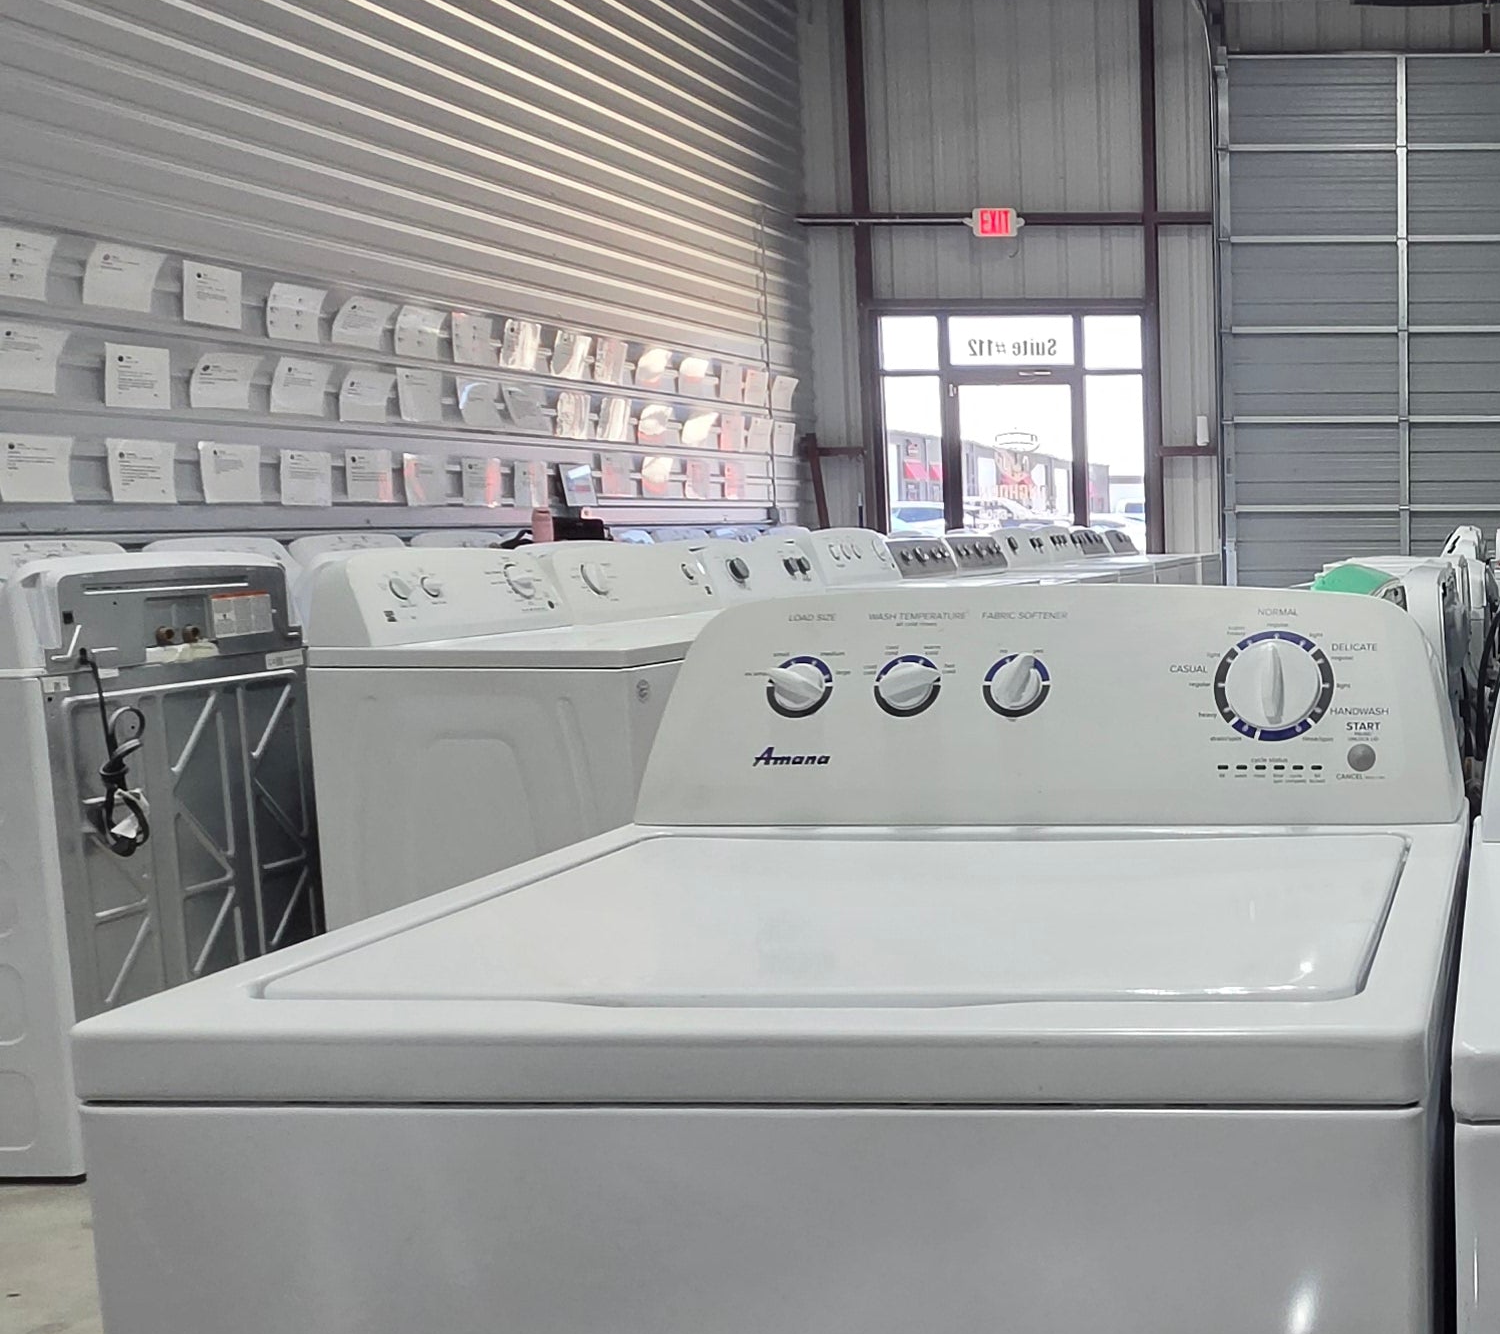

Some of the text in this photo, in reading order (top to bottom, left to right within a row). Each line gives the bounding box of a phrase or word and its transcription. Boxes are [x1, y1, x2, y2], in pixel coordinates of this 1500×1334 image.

[980, 209, 1009, 234] EXIT
[868, 611, 966, 620] WASH TEMPERATURE
[982, 611, 1068, 619] FABRIC SOFTENER
[1257, 608, 1297, 616] NORMAL
[789, 613, 836, 622] LOAD SIZE
[1331, 643, 1378, 652] DELICATE
[1170, 665, 1208, 673] CASUAL
[1330, 708, 1389, 716] HANDWASH
[1346, 722, 1380, 731] START
[753, 747, 830, 767] Amana
